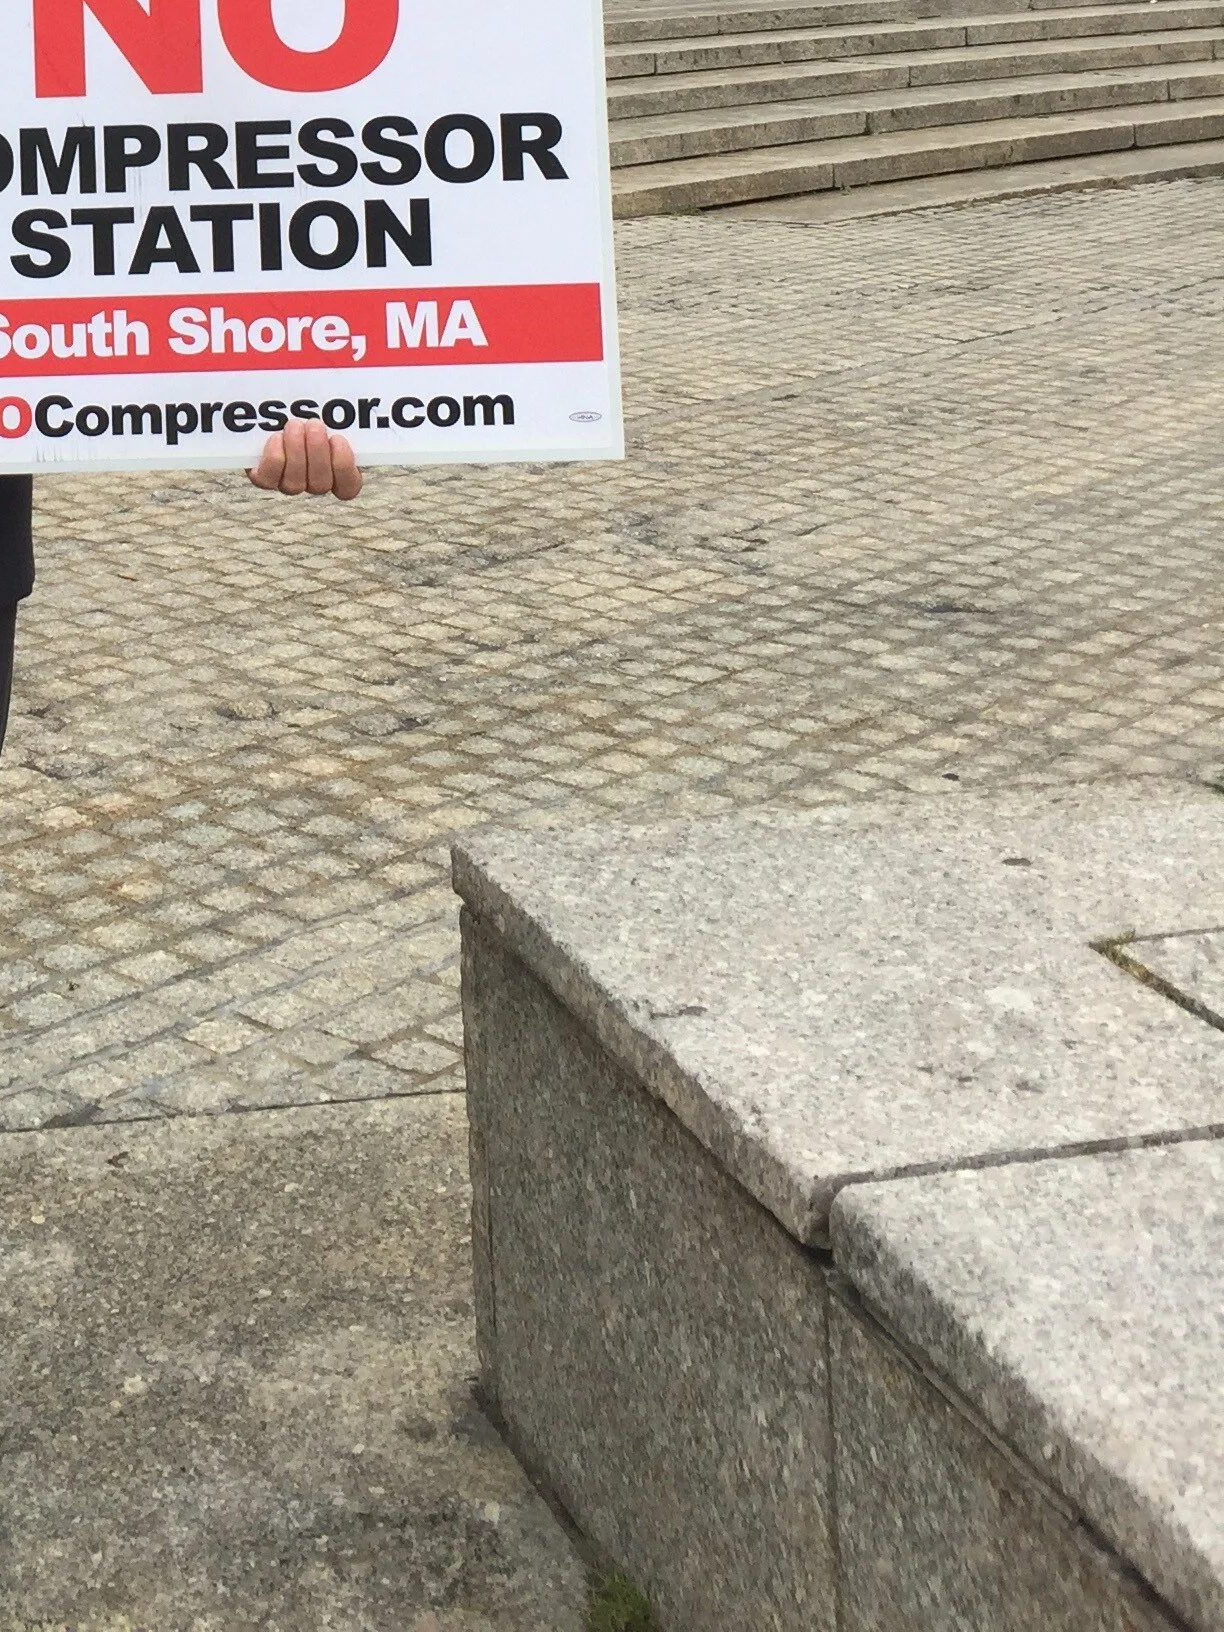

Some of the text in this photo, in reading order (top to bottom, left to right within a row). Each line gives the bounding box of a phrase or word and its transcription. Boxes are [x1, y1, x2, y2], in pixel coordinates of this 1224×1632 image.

[10, 198, 433, 279] STATION
[168, 306, 366, 362] Shore,
[385, 300, 488, 348] MA
